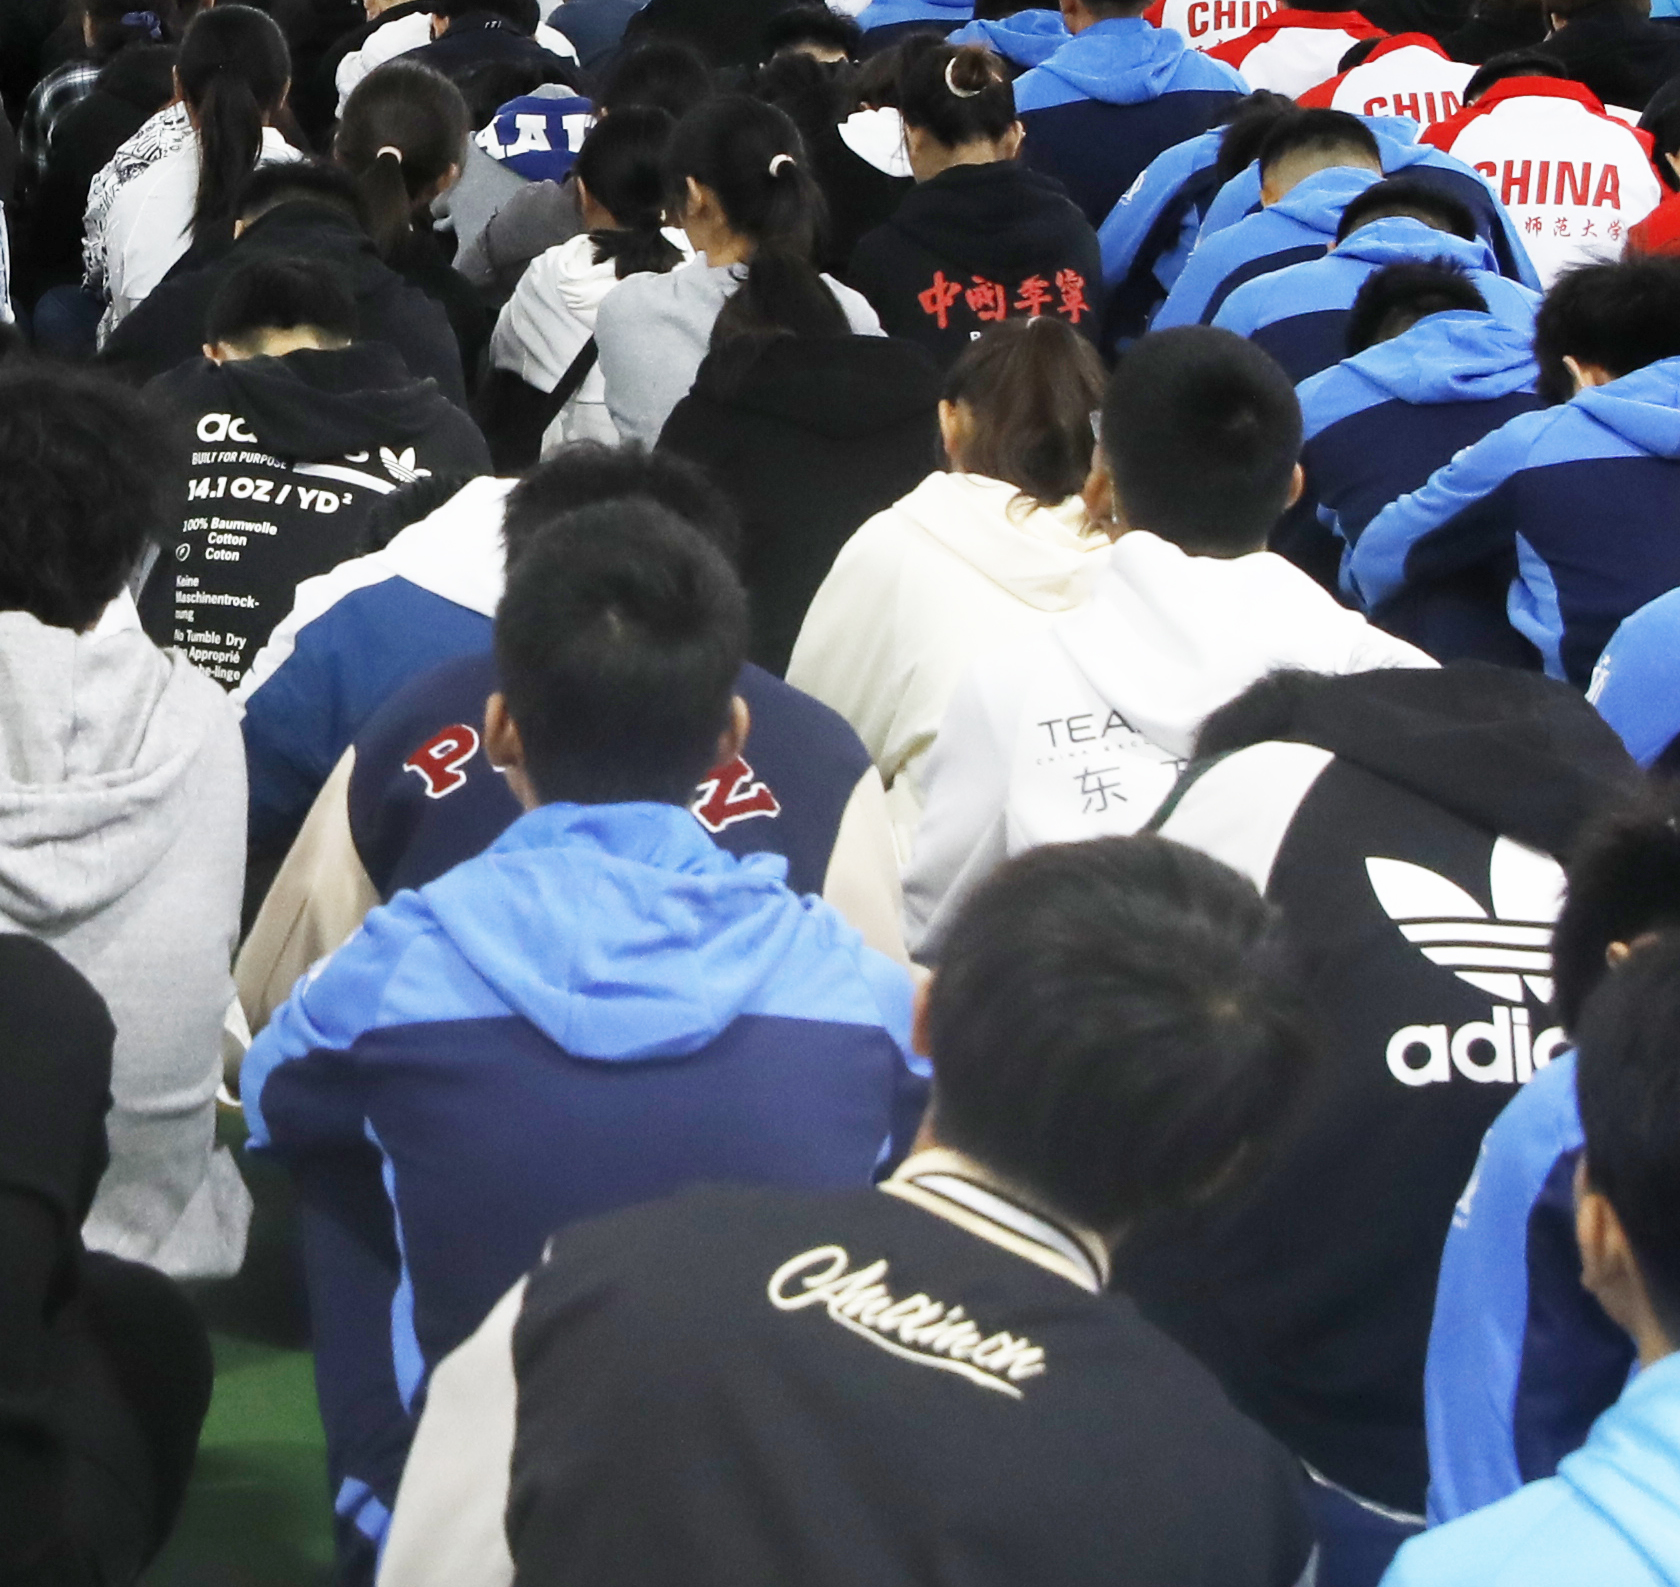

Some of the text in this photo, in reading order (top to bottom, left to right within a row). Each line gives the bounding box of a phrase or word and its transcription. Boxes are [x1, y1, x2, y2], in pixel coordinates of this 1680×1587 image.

[1187, 0, 1276, 38] CHIN
[1363, 90, 1463, 123] CHIN
[1474, 159, 1621, 210] CHINA
[1524, 215, 1625, 243] 师范大学
[191, 451, 287, 470] BUILT FOR PURPOSE
[187, 476, 225, 502] 14.1
[230, 476, 273, 504] OZ
[274, 483, 293, 506] /
[183, 517, 278, 536] 100% Baumwolle
[207, 531, 248, 547] Cotton
[205, 547, 240, 562] Coton
[176, 574, 200, 589] Keine
[186, 628, 222, 645] Tumble
[225, 631, 248, 651] Dry
[1037, 709, 1142, 749] TEA
[1387, 1005, 1569, 1086] adi
